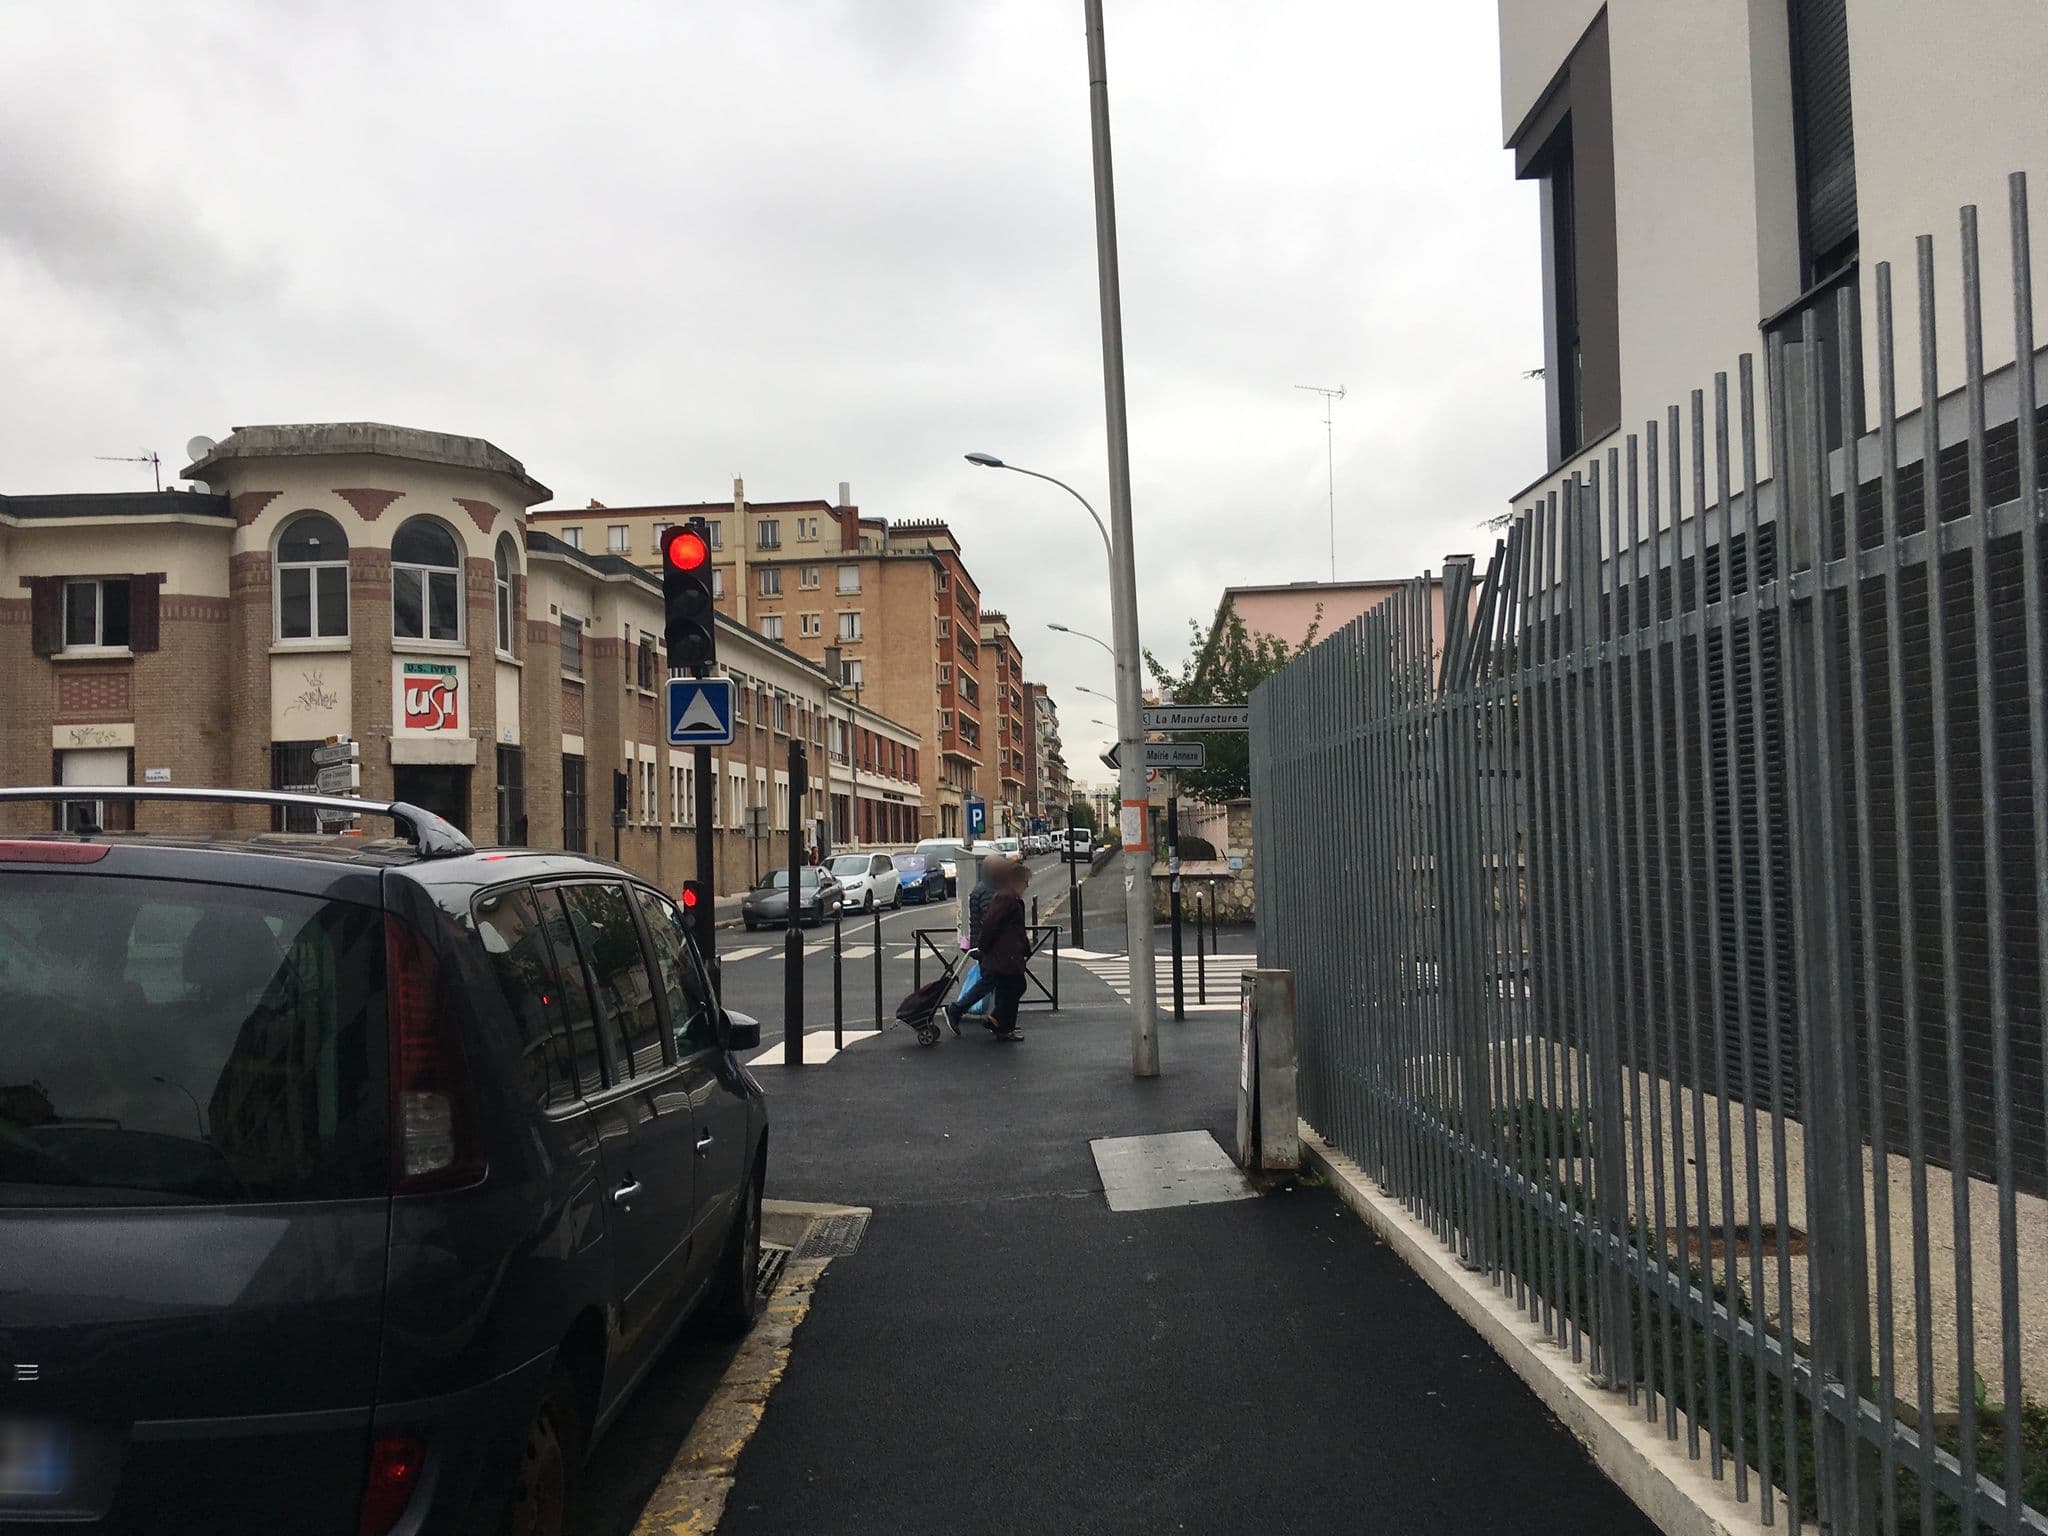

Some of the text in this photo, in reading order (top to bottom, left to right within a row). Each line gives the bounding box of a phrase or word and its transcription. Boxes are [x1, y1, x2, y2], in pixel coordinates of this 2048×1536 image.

[407, 664, 453, 674] U.S. IVRY
[1155, 714, 1167, 724] La
[1171, 713, 1238, 724] Manufacture
[1146, 750, 1198, 761] Mairie Annexe
[972, 808, 983, 828] P
